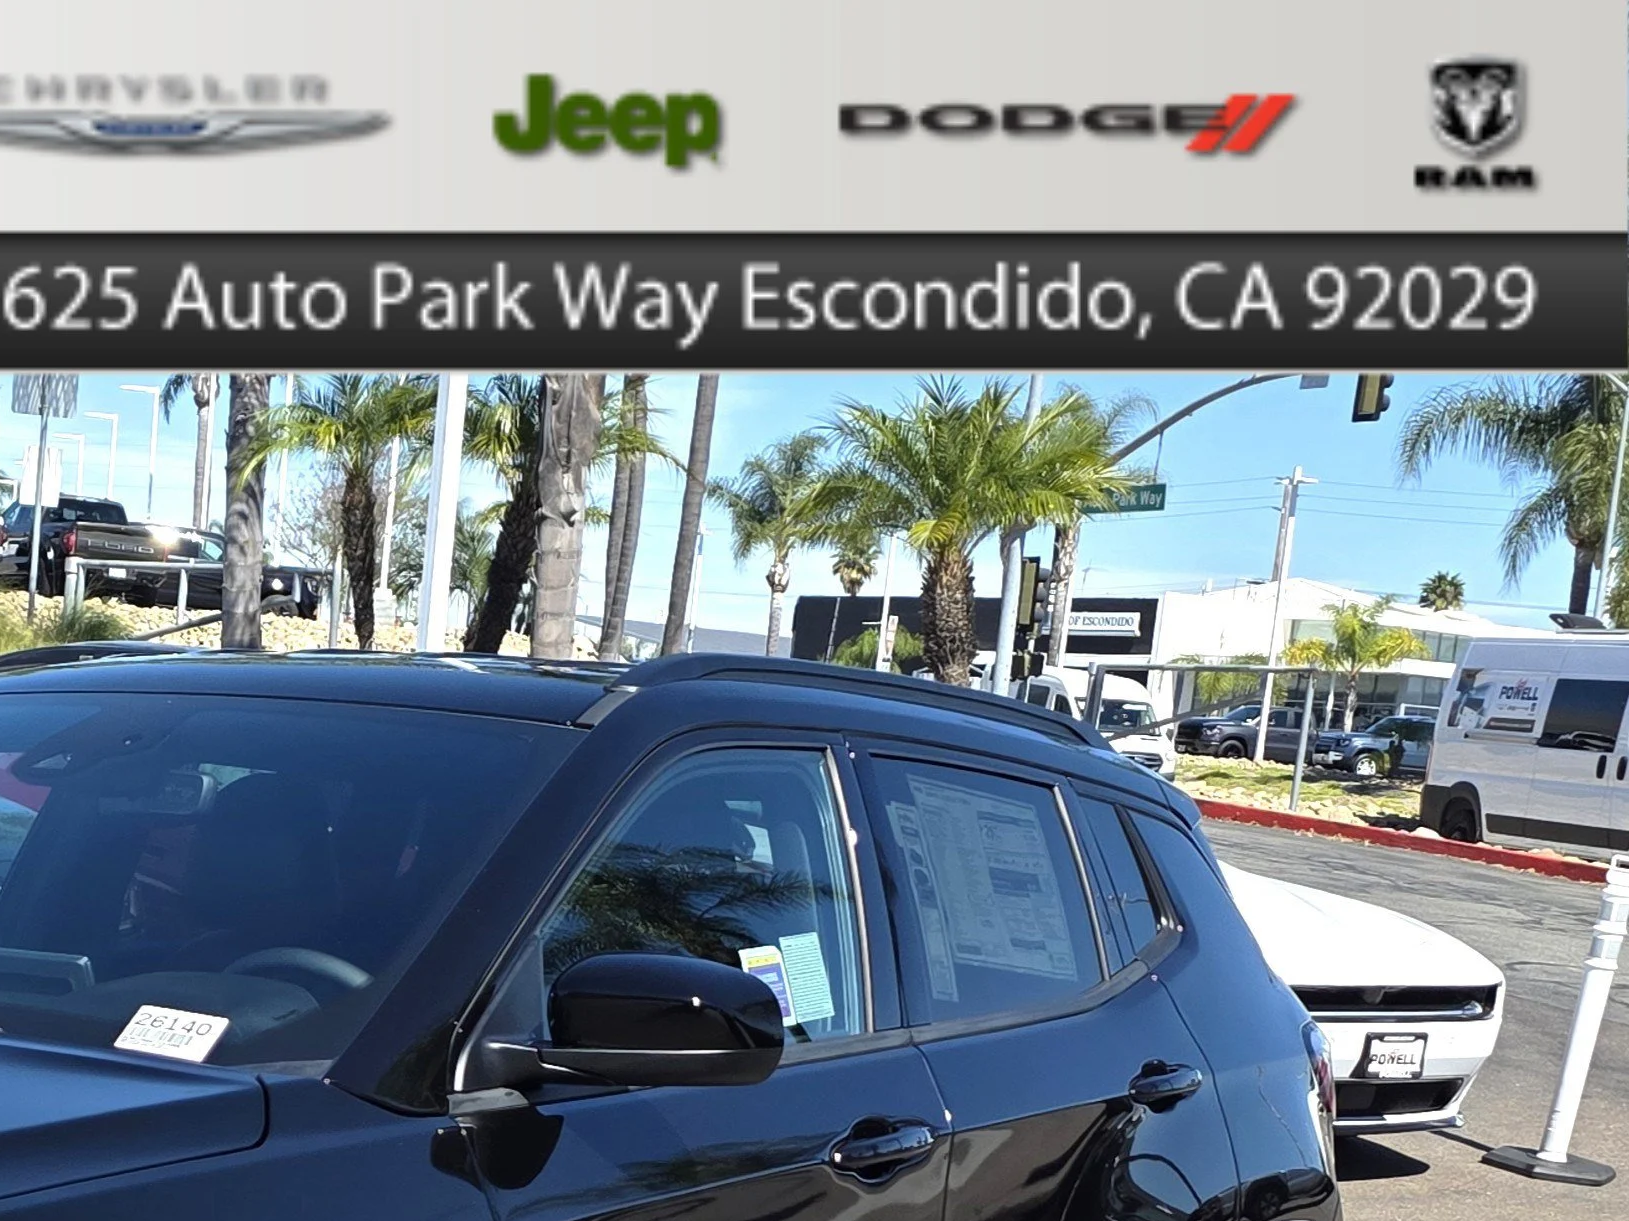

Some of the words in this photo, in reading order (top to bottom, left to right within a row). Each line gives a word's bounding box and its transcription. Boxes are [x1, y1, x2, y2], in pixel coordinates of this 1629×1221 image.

[1140, 489, 1163, 508] Way
[1082, 616, 1134, 627] ESCONDIDO
[1498, 686, 1539, 700] POWELL
[135, 1012, 213, 1036] 26140
